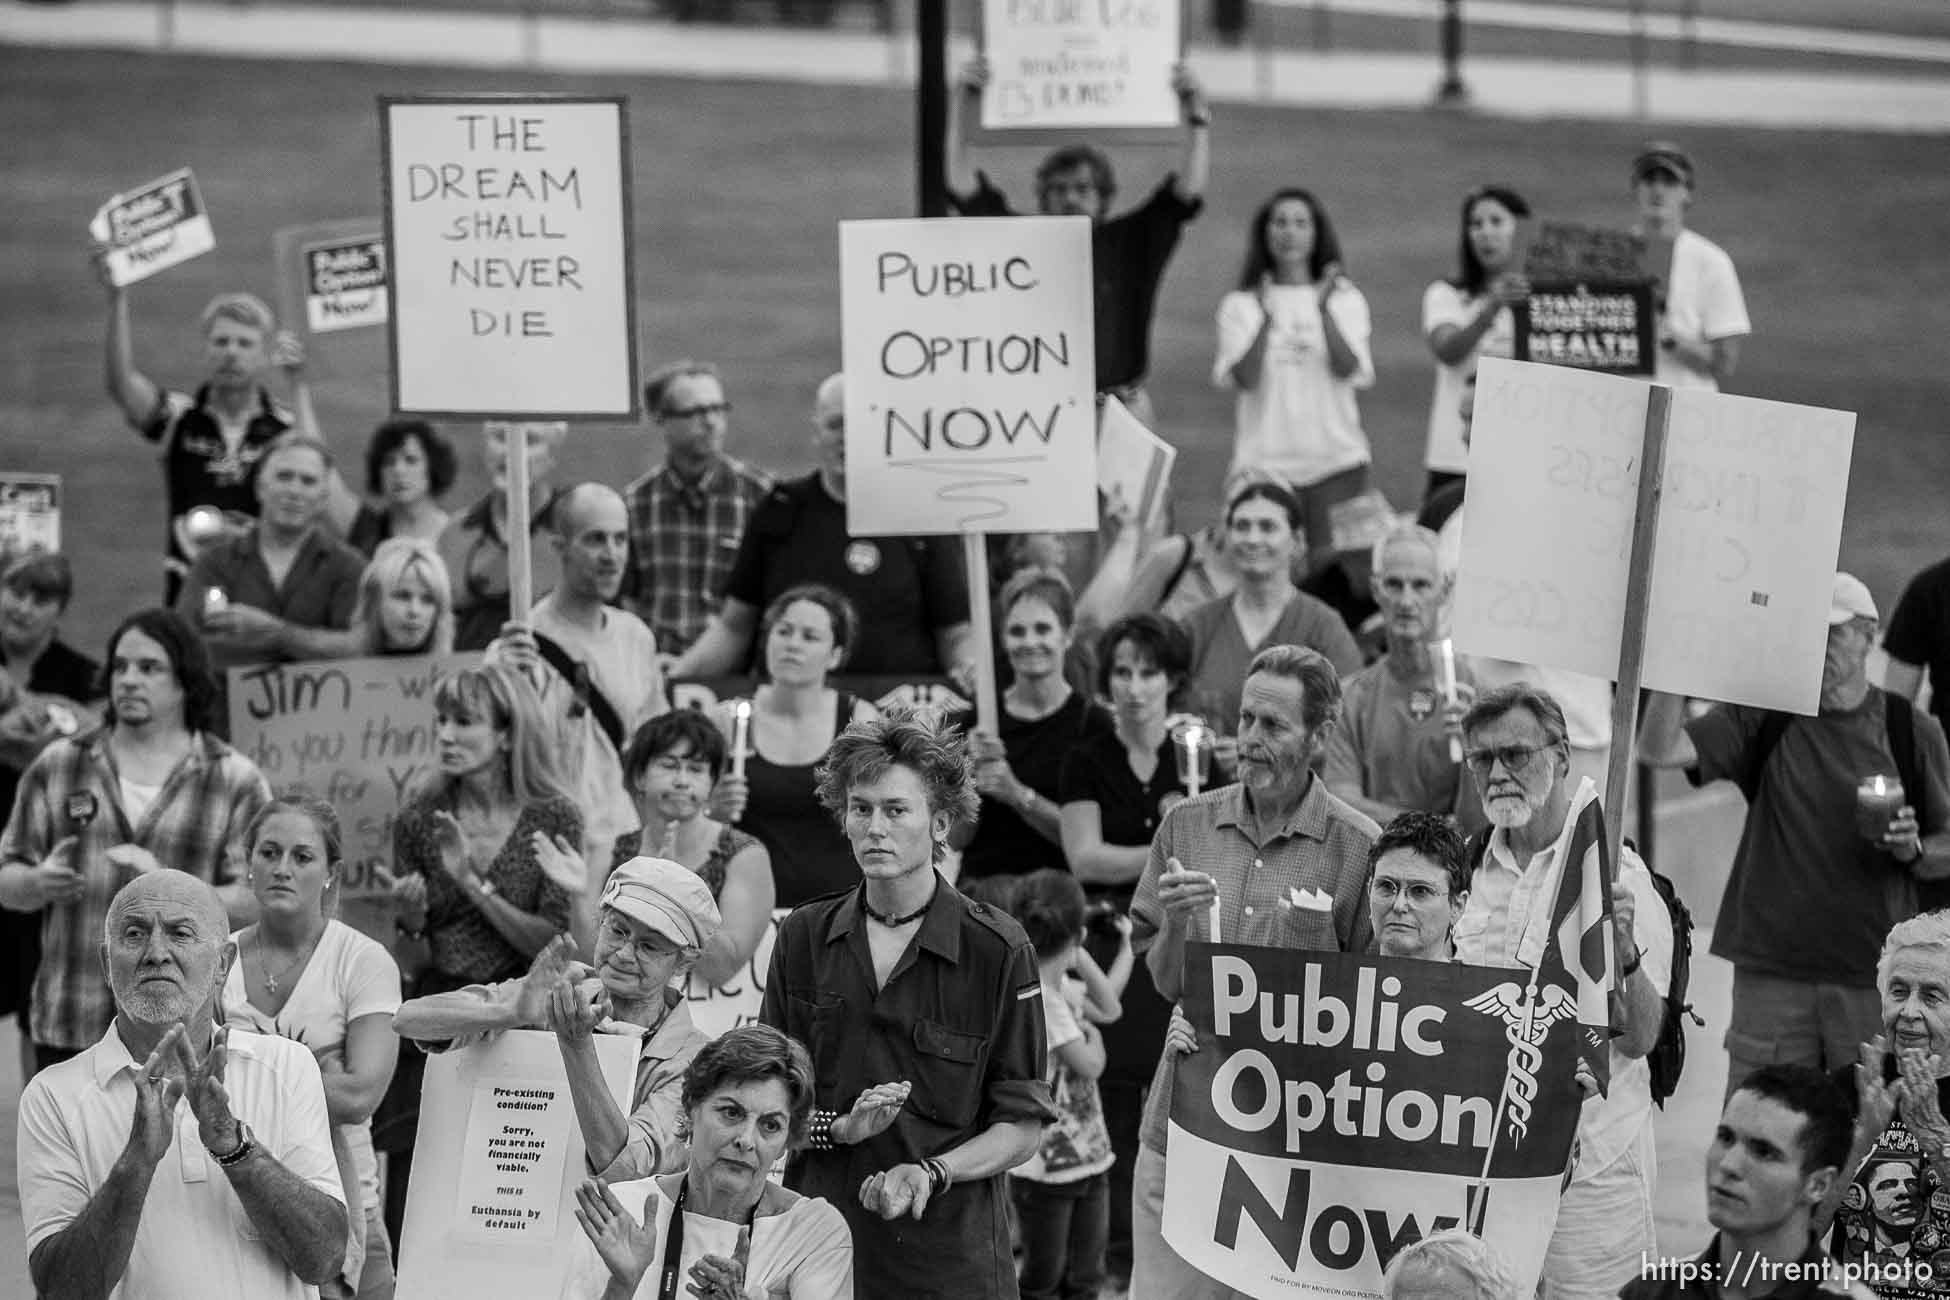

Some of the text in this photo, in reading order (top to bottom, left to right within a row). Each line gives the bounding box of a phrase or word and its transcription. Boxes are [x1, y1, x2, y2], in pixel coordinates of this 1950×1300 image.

[457, 115, 545, 152] THE
[408, 163, 581, 209] DREAM
[444, 213, 567, 241] SHALL
[450, 255, 583, 290] NEVER
[877, 251, 1039, 297] PUBLIC
[470, 308, 553, 337] DIE
[880, 330, 1070, 380] OPTION
[1211, 955, 1448, 1057] Public
[493, 1087, 555, 1101] Pre-existing
[496, 1100, 549, 1112] condition?
[1211, 1048, 1493, 1153] Option
[488, 1138, 546, 1149] you are not
[502, 1125, 534, 1137] Sorry,
[487, 1149, 542, 1163] financially
[496, 1186, 525, 1196] THIS IS
[484, 1218, 528, 1230] default
[527, 1207, 541, 1220] by
